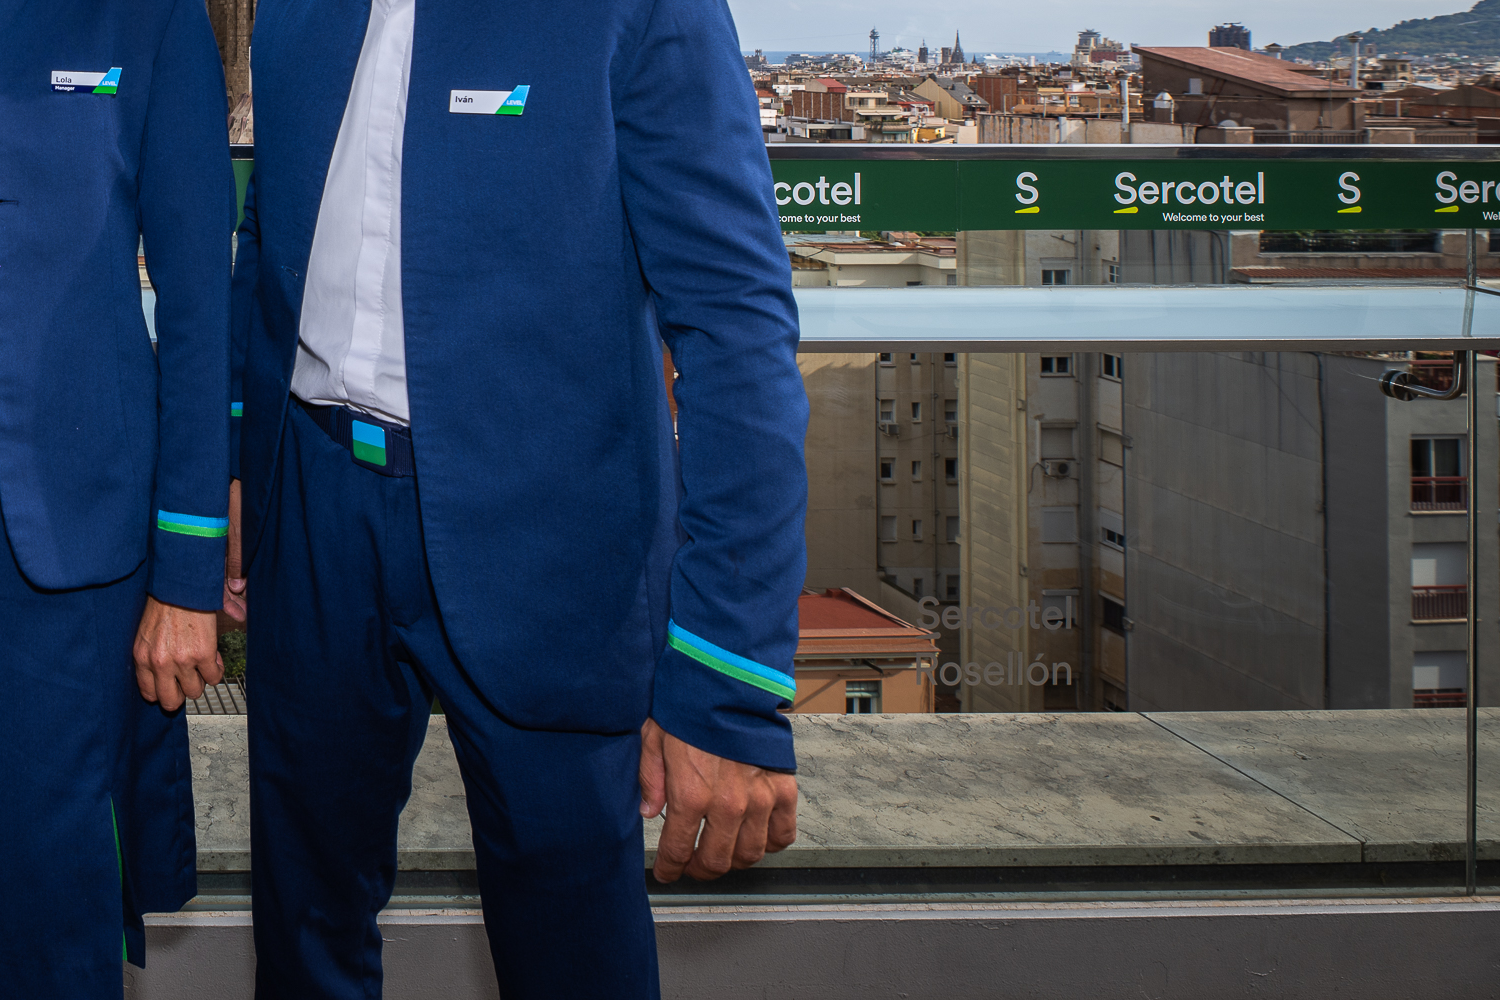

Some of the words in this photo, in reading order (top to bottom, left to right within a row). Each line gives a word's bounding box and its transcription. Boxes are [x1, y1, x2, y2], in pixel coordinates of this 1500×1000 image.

[455, 95, 473, 103] Iván
[1015, 171, 1040, 205] S
[1113, 171, 1265, 205] Sercotel
[1337, 171, 1362, 204] S
[804, 214, 815, 223] to
[816, 215, 839, 225] your
[840, 213, 861, 223] best
[1162, 212, 1207, 222] Welcome
[1209, 213, 1219, 222] to
[1220, 214, 1243, 224] your
[1244, 212, 1265, 222] best
[916, 596, 1072, 630] Sercotel
[915, 652, 1072, 687] Rosellón
